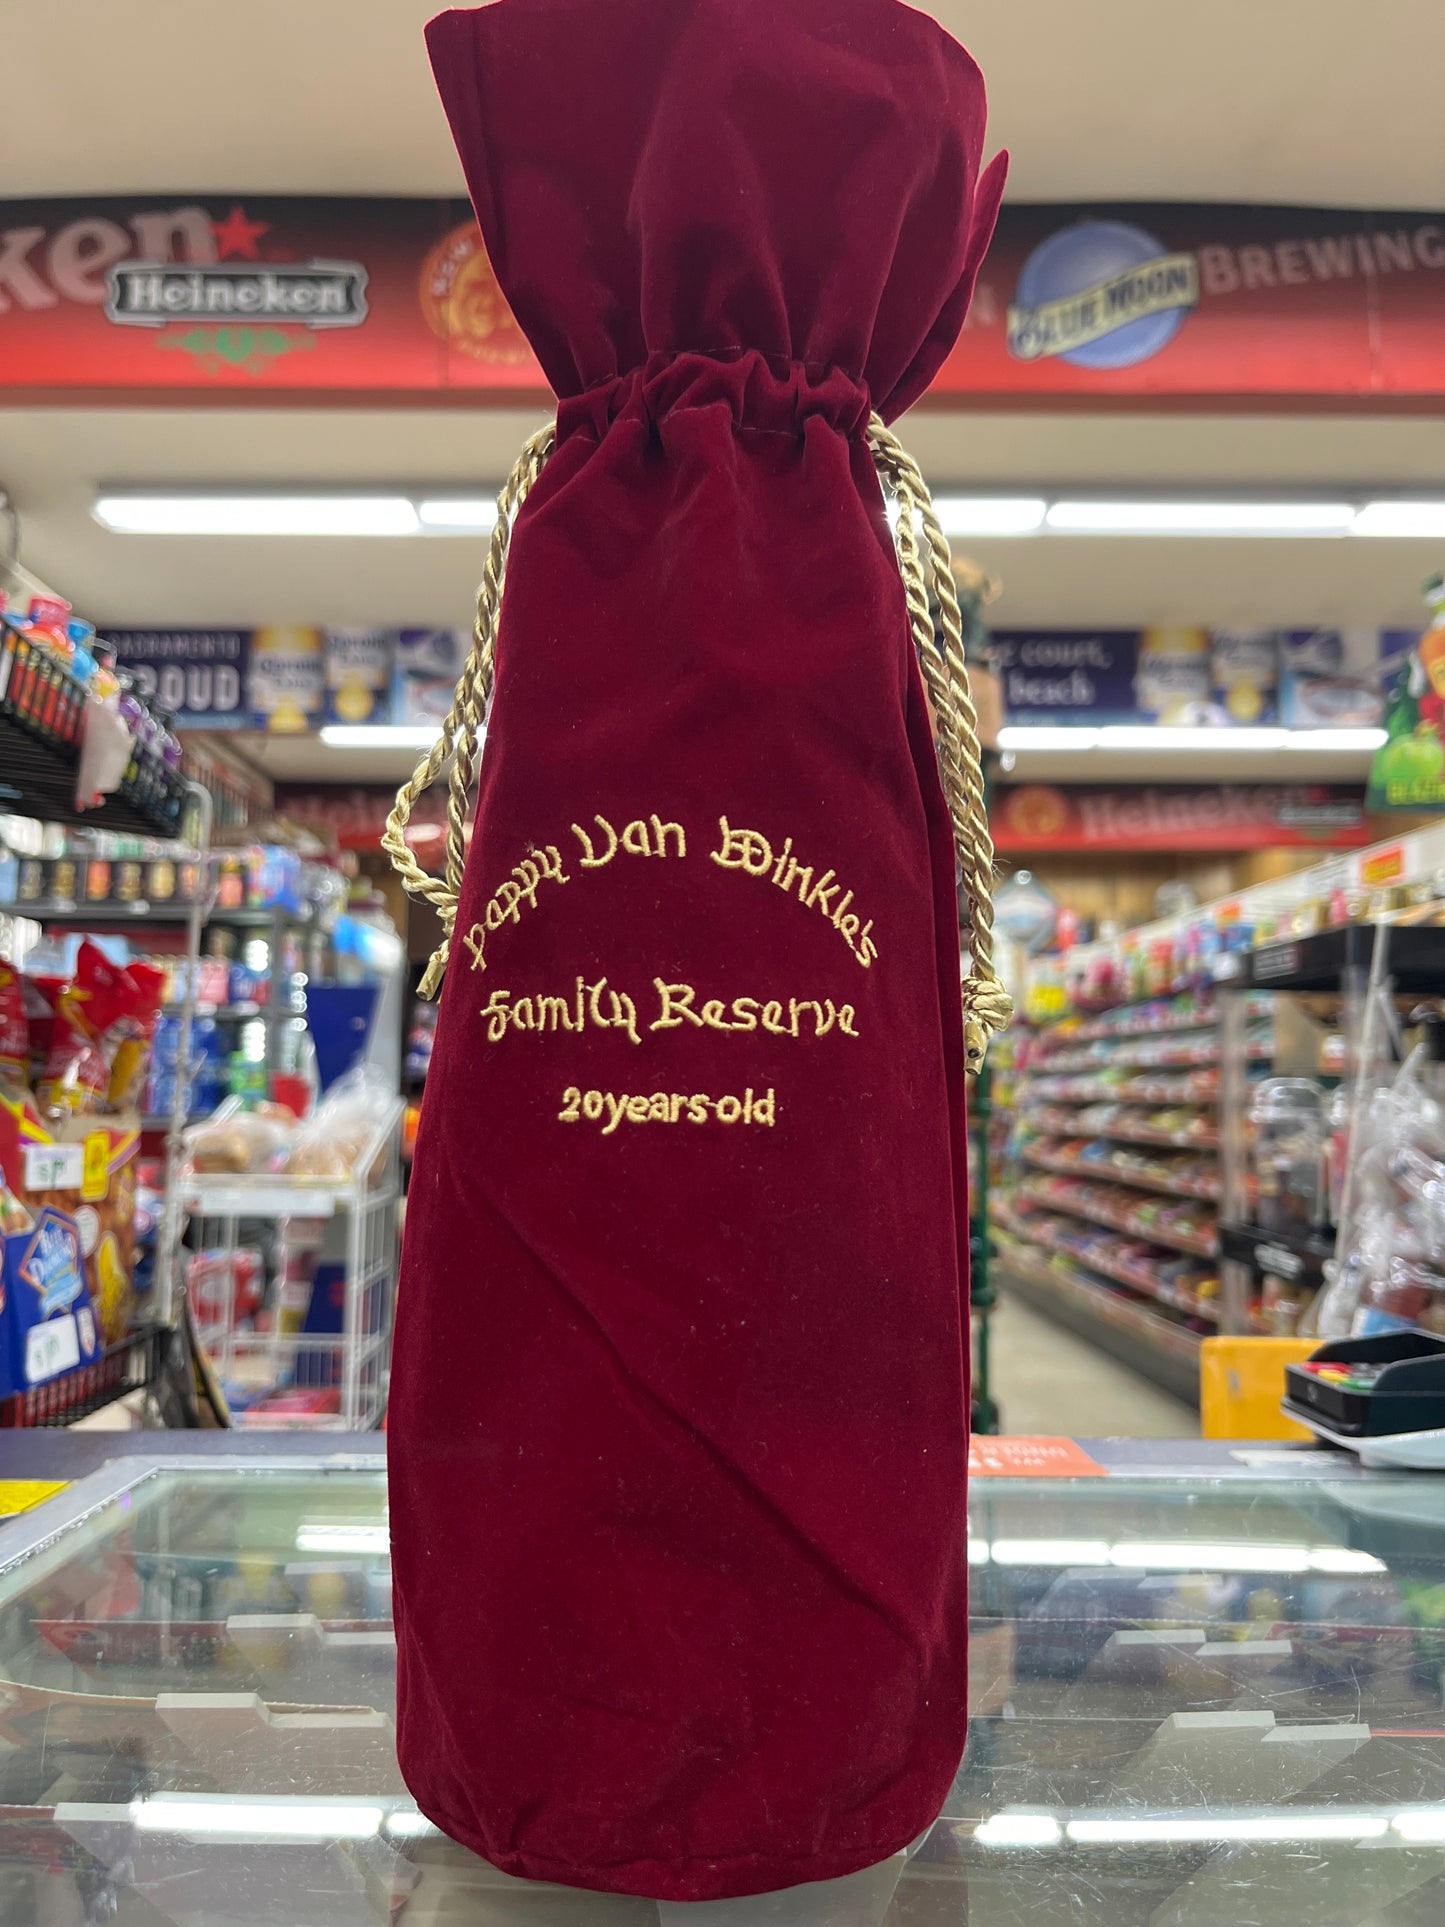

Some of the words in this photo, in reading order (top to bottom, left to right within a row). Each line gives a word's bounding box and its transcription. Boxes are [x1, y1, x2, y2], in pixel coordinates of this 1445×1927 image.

[128, 272, 349, 313] Heineken
[1201, 226, 1445, 297] BREWING
[1012, 298, 1097, 356] BLUE
[1103, 263, 1190, 313] MOON
[571, 814, 686, 867] Van
[480, 976, 641, 1044] Family
[649, 977, 859, 1037] Reserve
